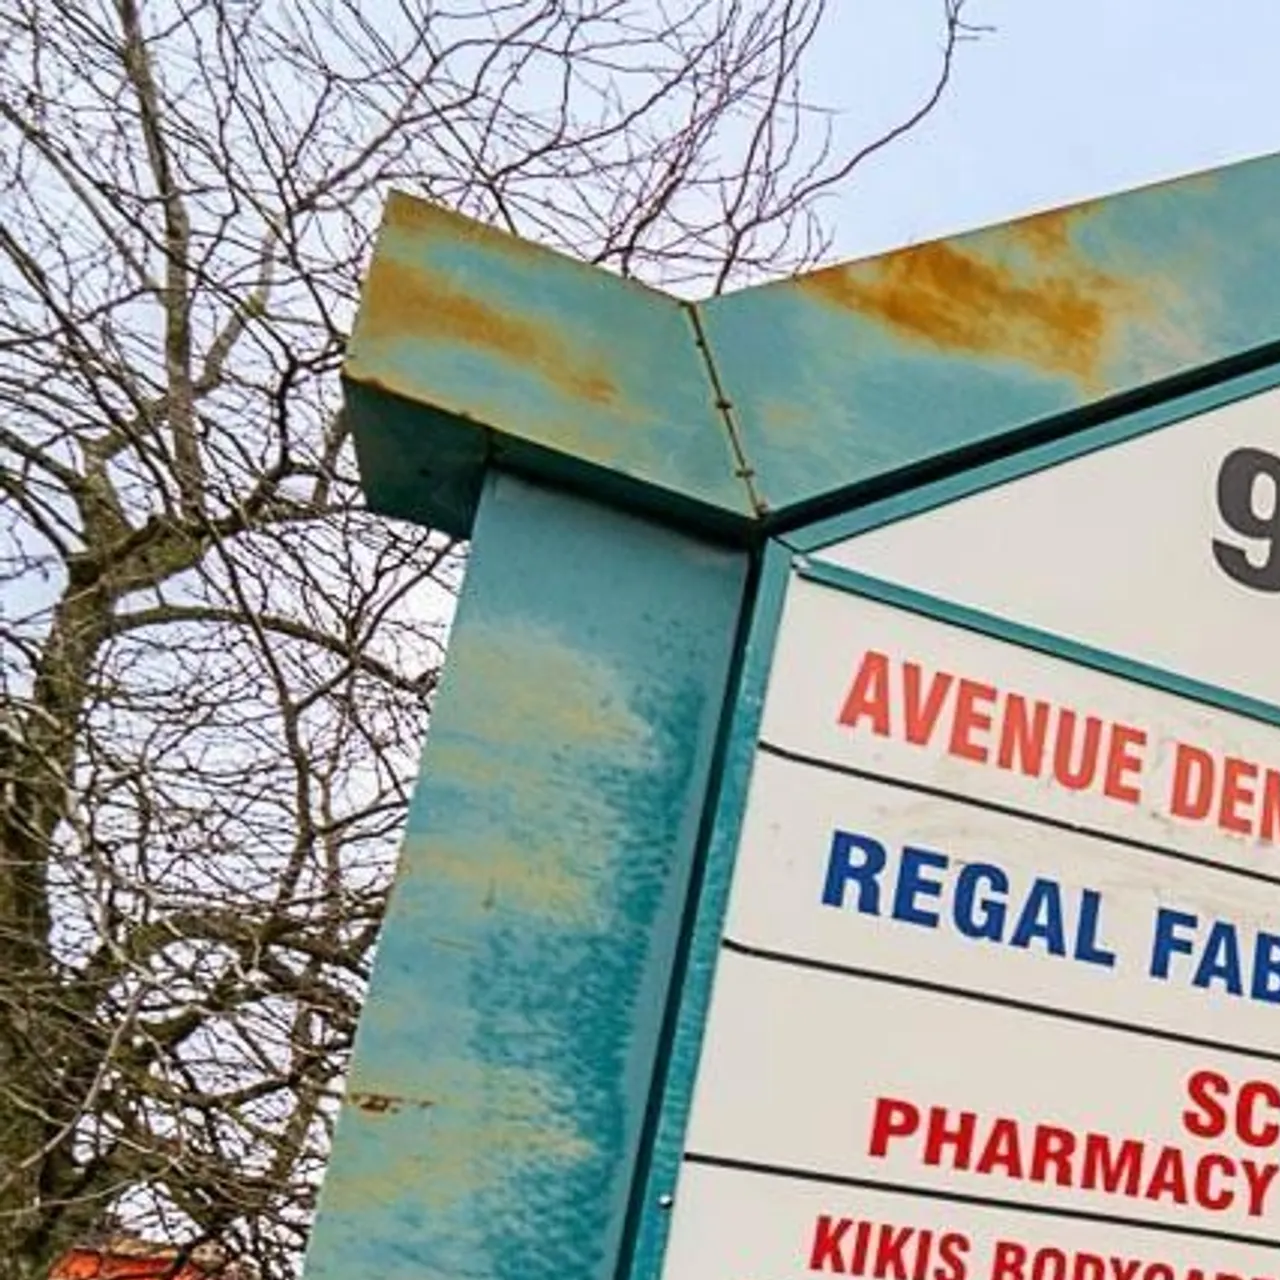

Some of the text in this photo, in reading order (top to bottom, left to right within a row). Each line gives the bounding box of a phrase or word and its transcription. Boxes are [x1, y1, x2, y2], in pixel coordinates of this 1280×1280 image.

[838, 648, 1146, 801] AVENUE
[820, 828, 1117, 968] REGAL
[867, 1097, 1279, 1217] PHARMACY
